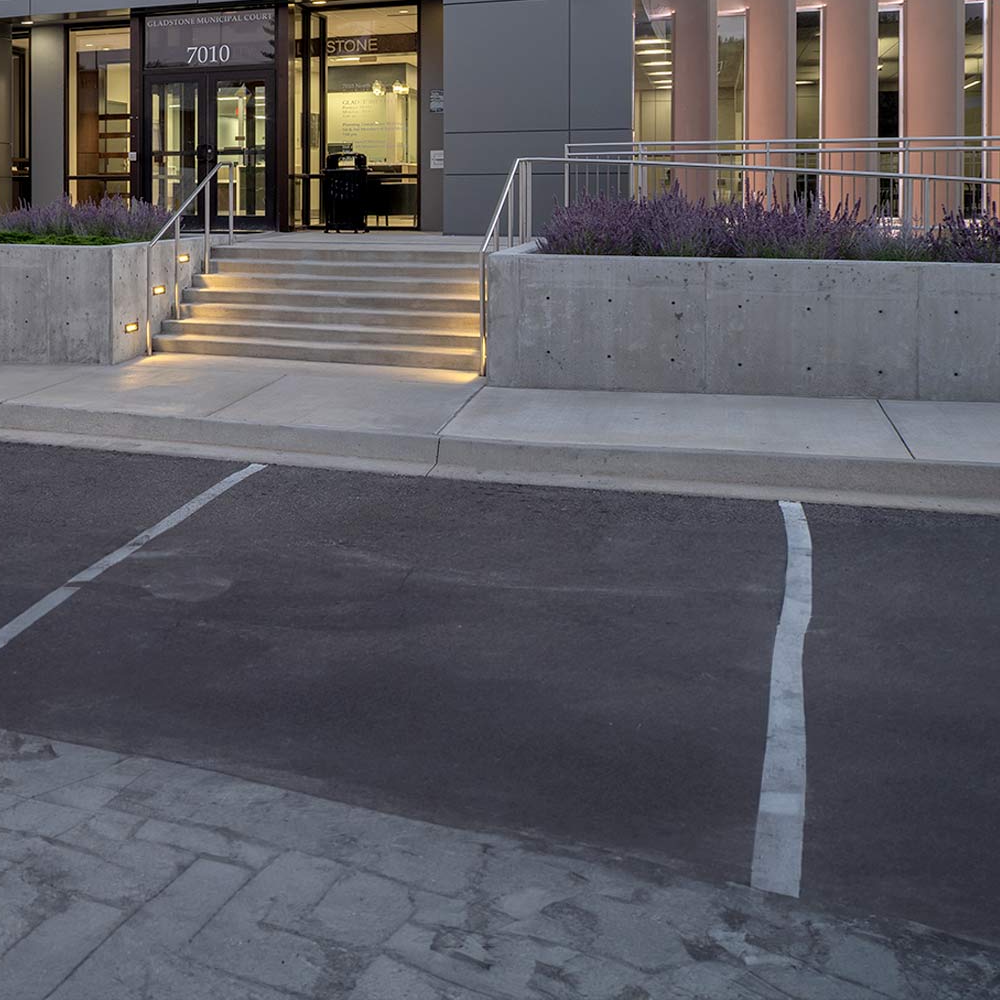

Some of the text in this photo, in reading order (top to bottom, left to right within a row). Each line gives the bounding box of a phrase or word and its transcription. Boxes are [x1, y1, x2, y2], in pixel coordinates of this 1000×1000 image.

[146, 12, 273, 28] GLADSTONE MUNICIPAL COURT
[186, 44, 231, 64] 7010
